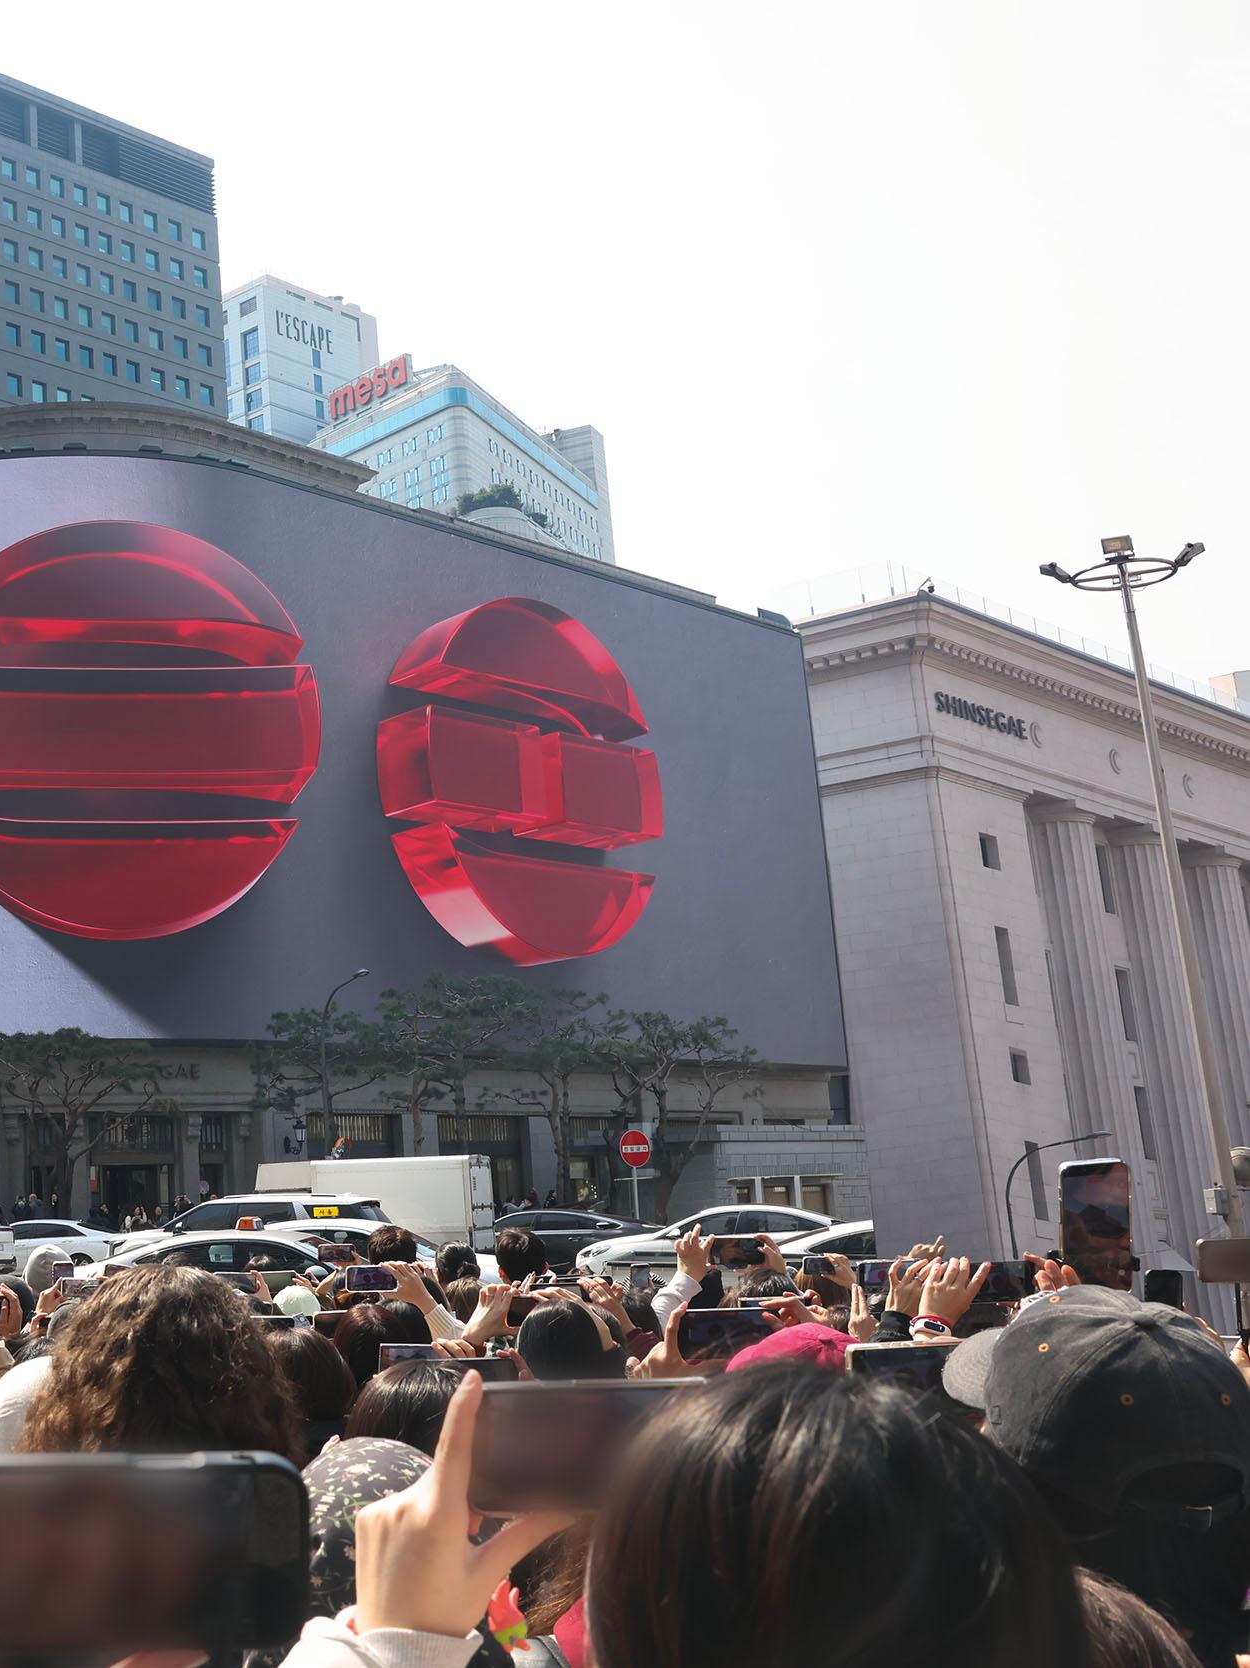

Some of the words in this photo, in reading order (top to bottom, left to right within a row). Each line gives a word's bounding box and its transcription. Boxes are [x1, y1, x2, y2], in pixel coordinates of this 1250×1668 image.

[275, 309, 333, 355] L'ESCAPE
[329, 355, 408, 421] mesa
[934, 691, 1028, 740] SHINSEGAE
